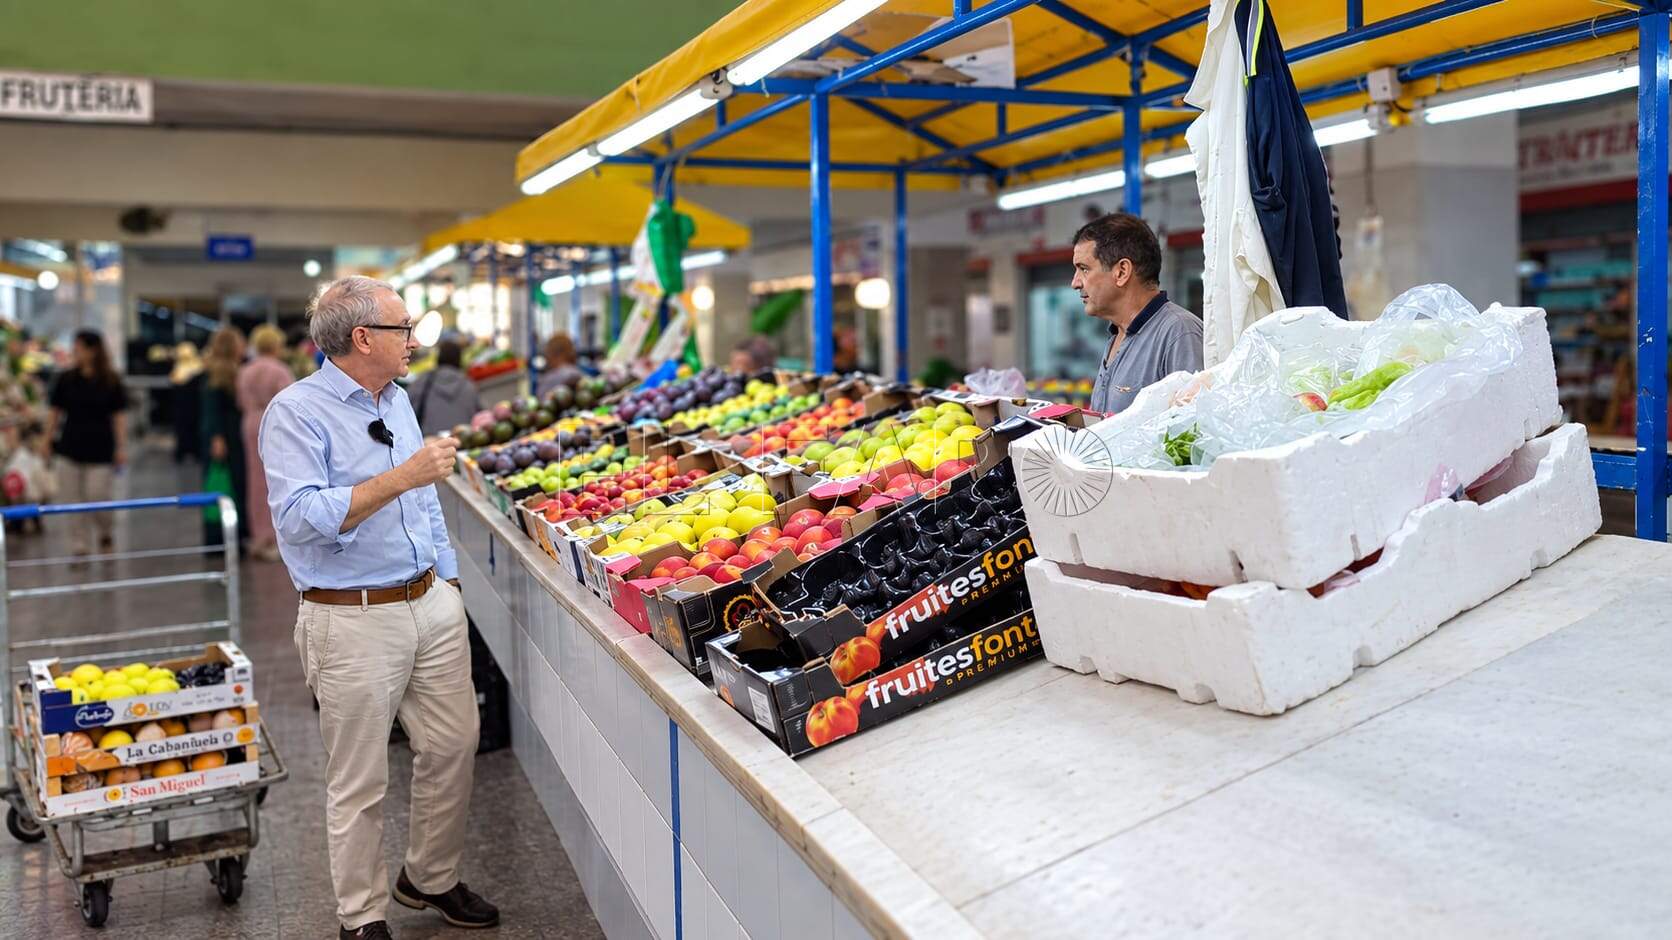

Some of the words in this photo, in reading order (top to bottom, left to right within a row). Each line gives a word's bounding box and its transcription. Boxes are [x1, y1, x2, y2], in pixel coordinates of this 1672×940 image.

[884, 536, 1035, 640] fruitesfon
[130, 784, 156, 798] San
[160, 774, 206, 796] Miguel
